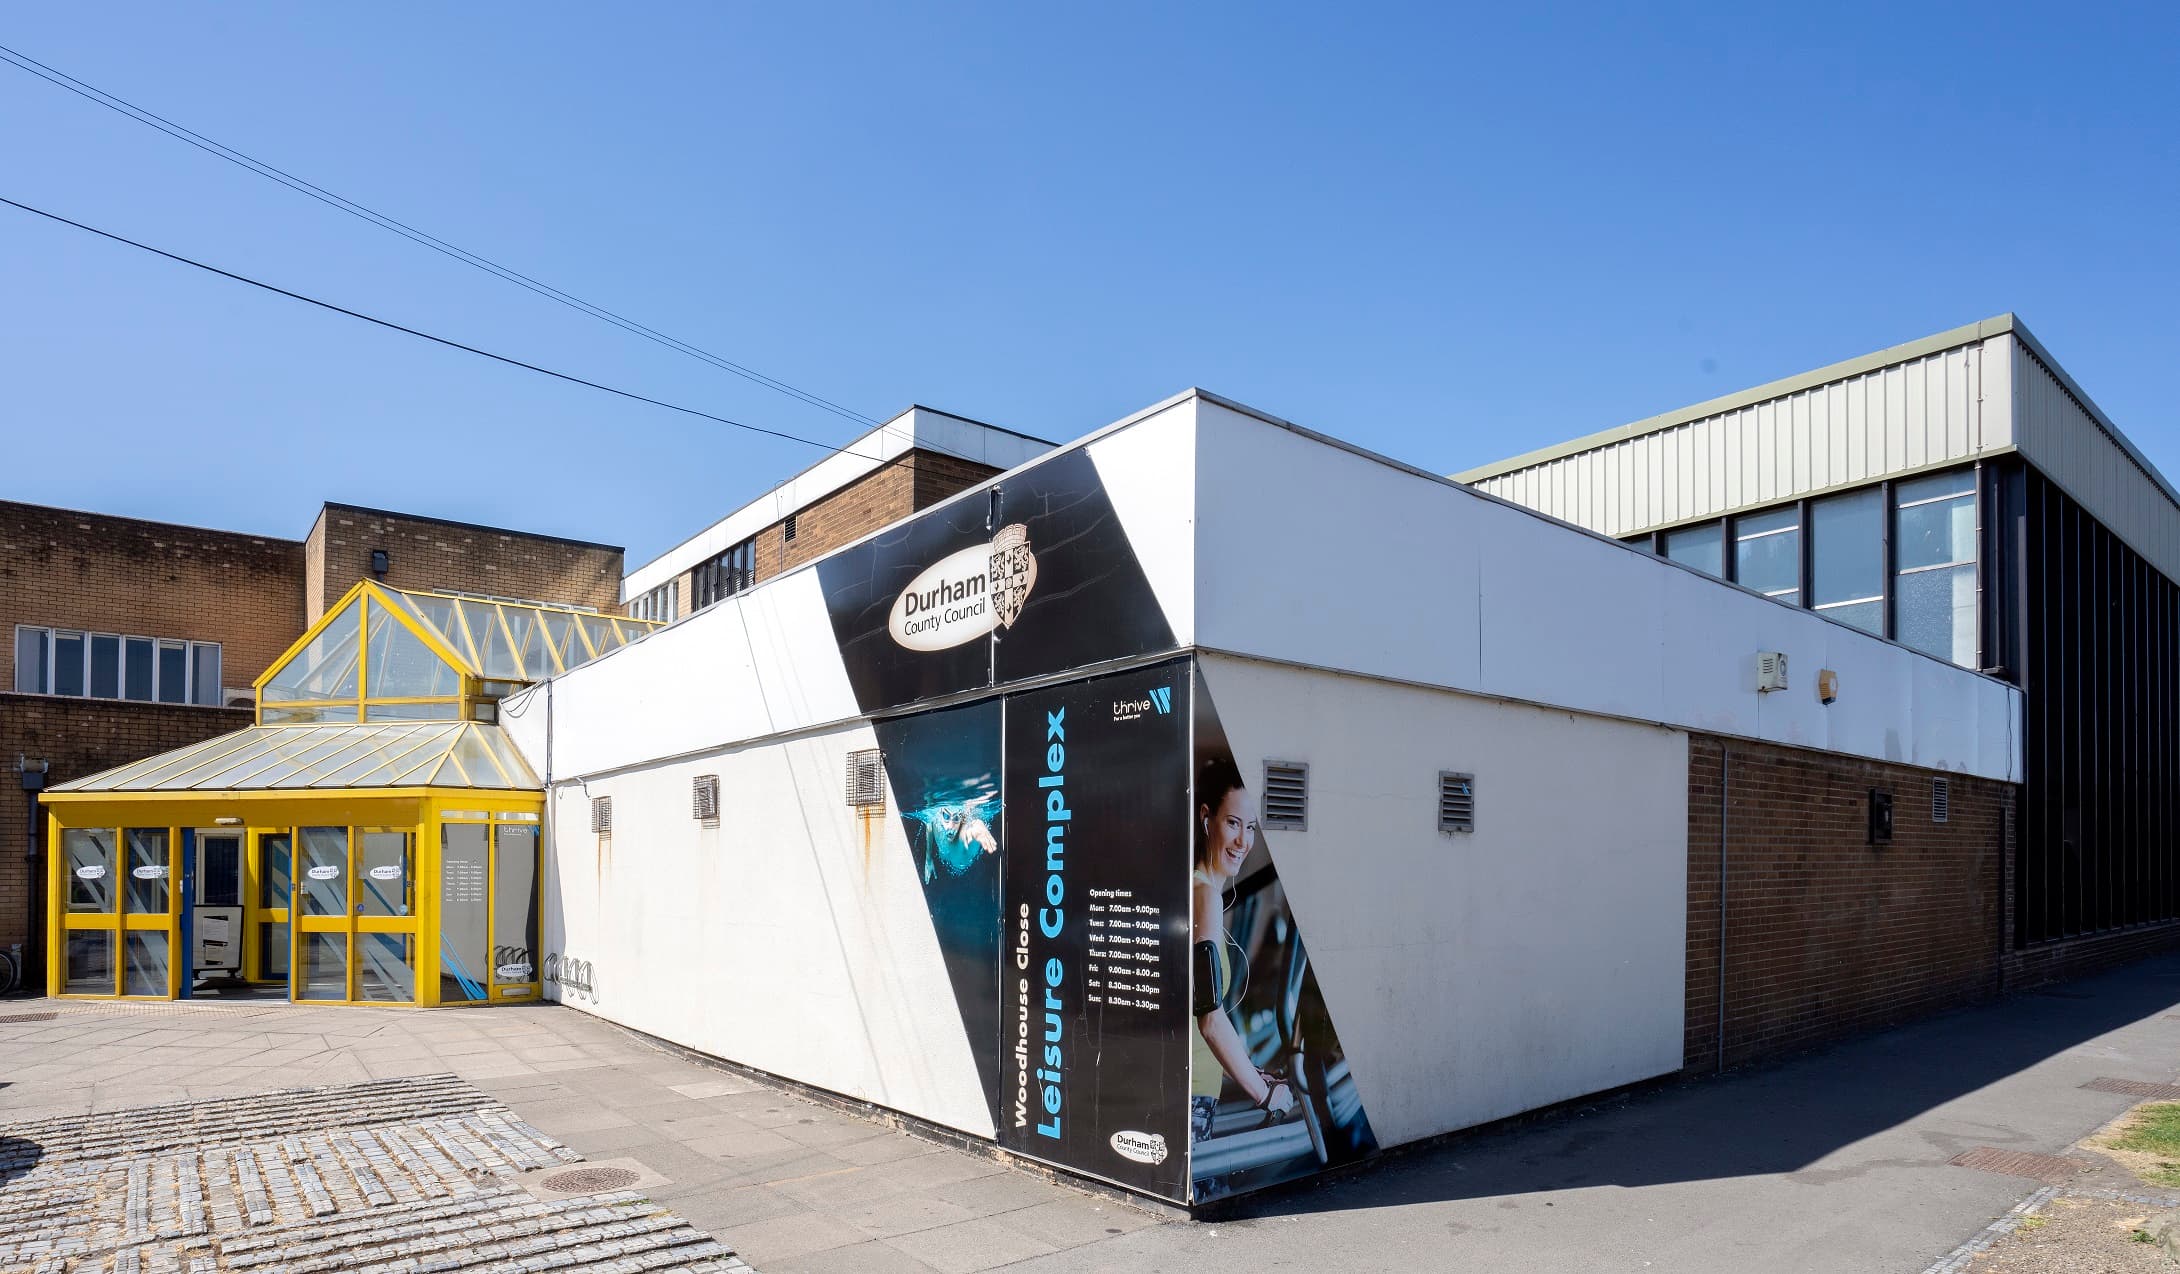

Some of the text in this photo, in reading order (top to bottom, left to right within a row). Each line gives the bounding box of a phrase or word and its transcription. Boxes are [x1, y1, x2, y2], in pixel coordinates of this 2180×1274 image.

[904, 573, 986, 617] Durham
[904, 597, 986, 636] County Council
[1113, 700, 1150, 715] thrive
[1089, 888, 1132, 899] Opening times
[1135, 905, 1160, 916] 9.00pm
[1036, 706, 1072, 1139] Leisure Complex
[1135, 921, 1160, 931] 9.00pm
[1135, 936, 1160, 947] 9.00pm
[1135, 952, 1159, 963] 9.00pm
[1135, 983, 1160, 994] 3.30pm
[1135, 999, 1160, 1011] 3.30pm
[1015, 903, 1029, 1128] Woodhouse Close
[1117, 1134, 1150, 1150] Durham
